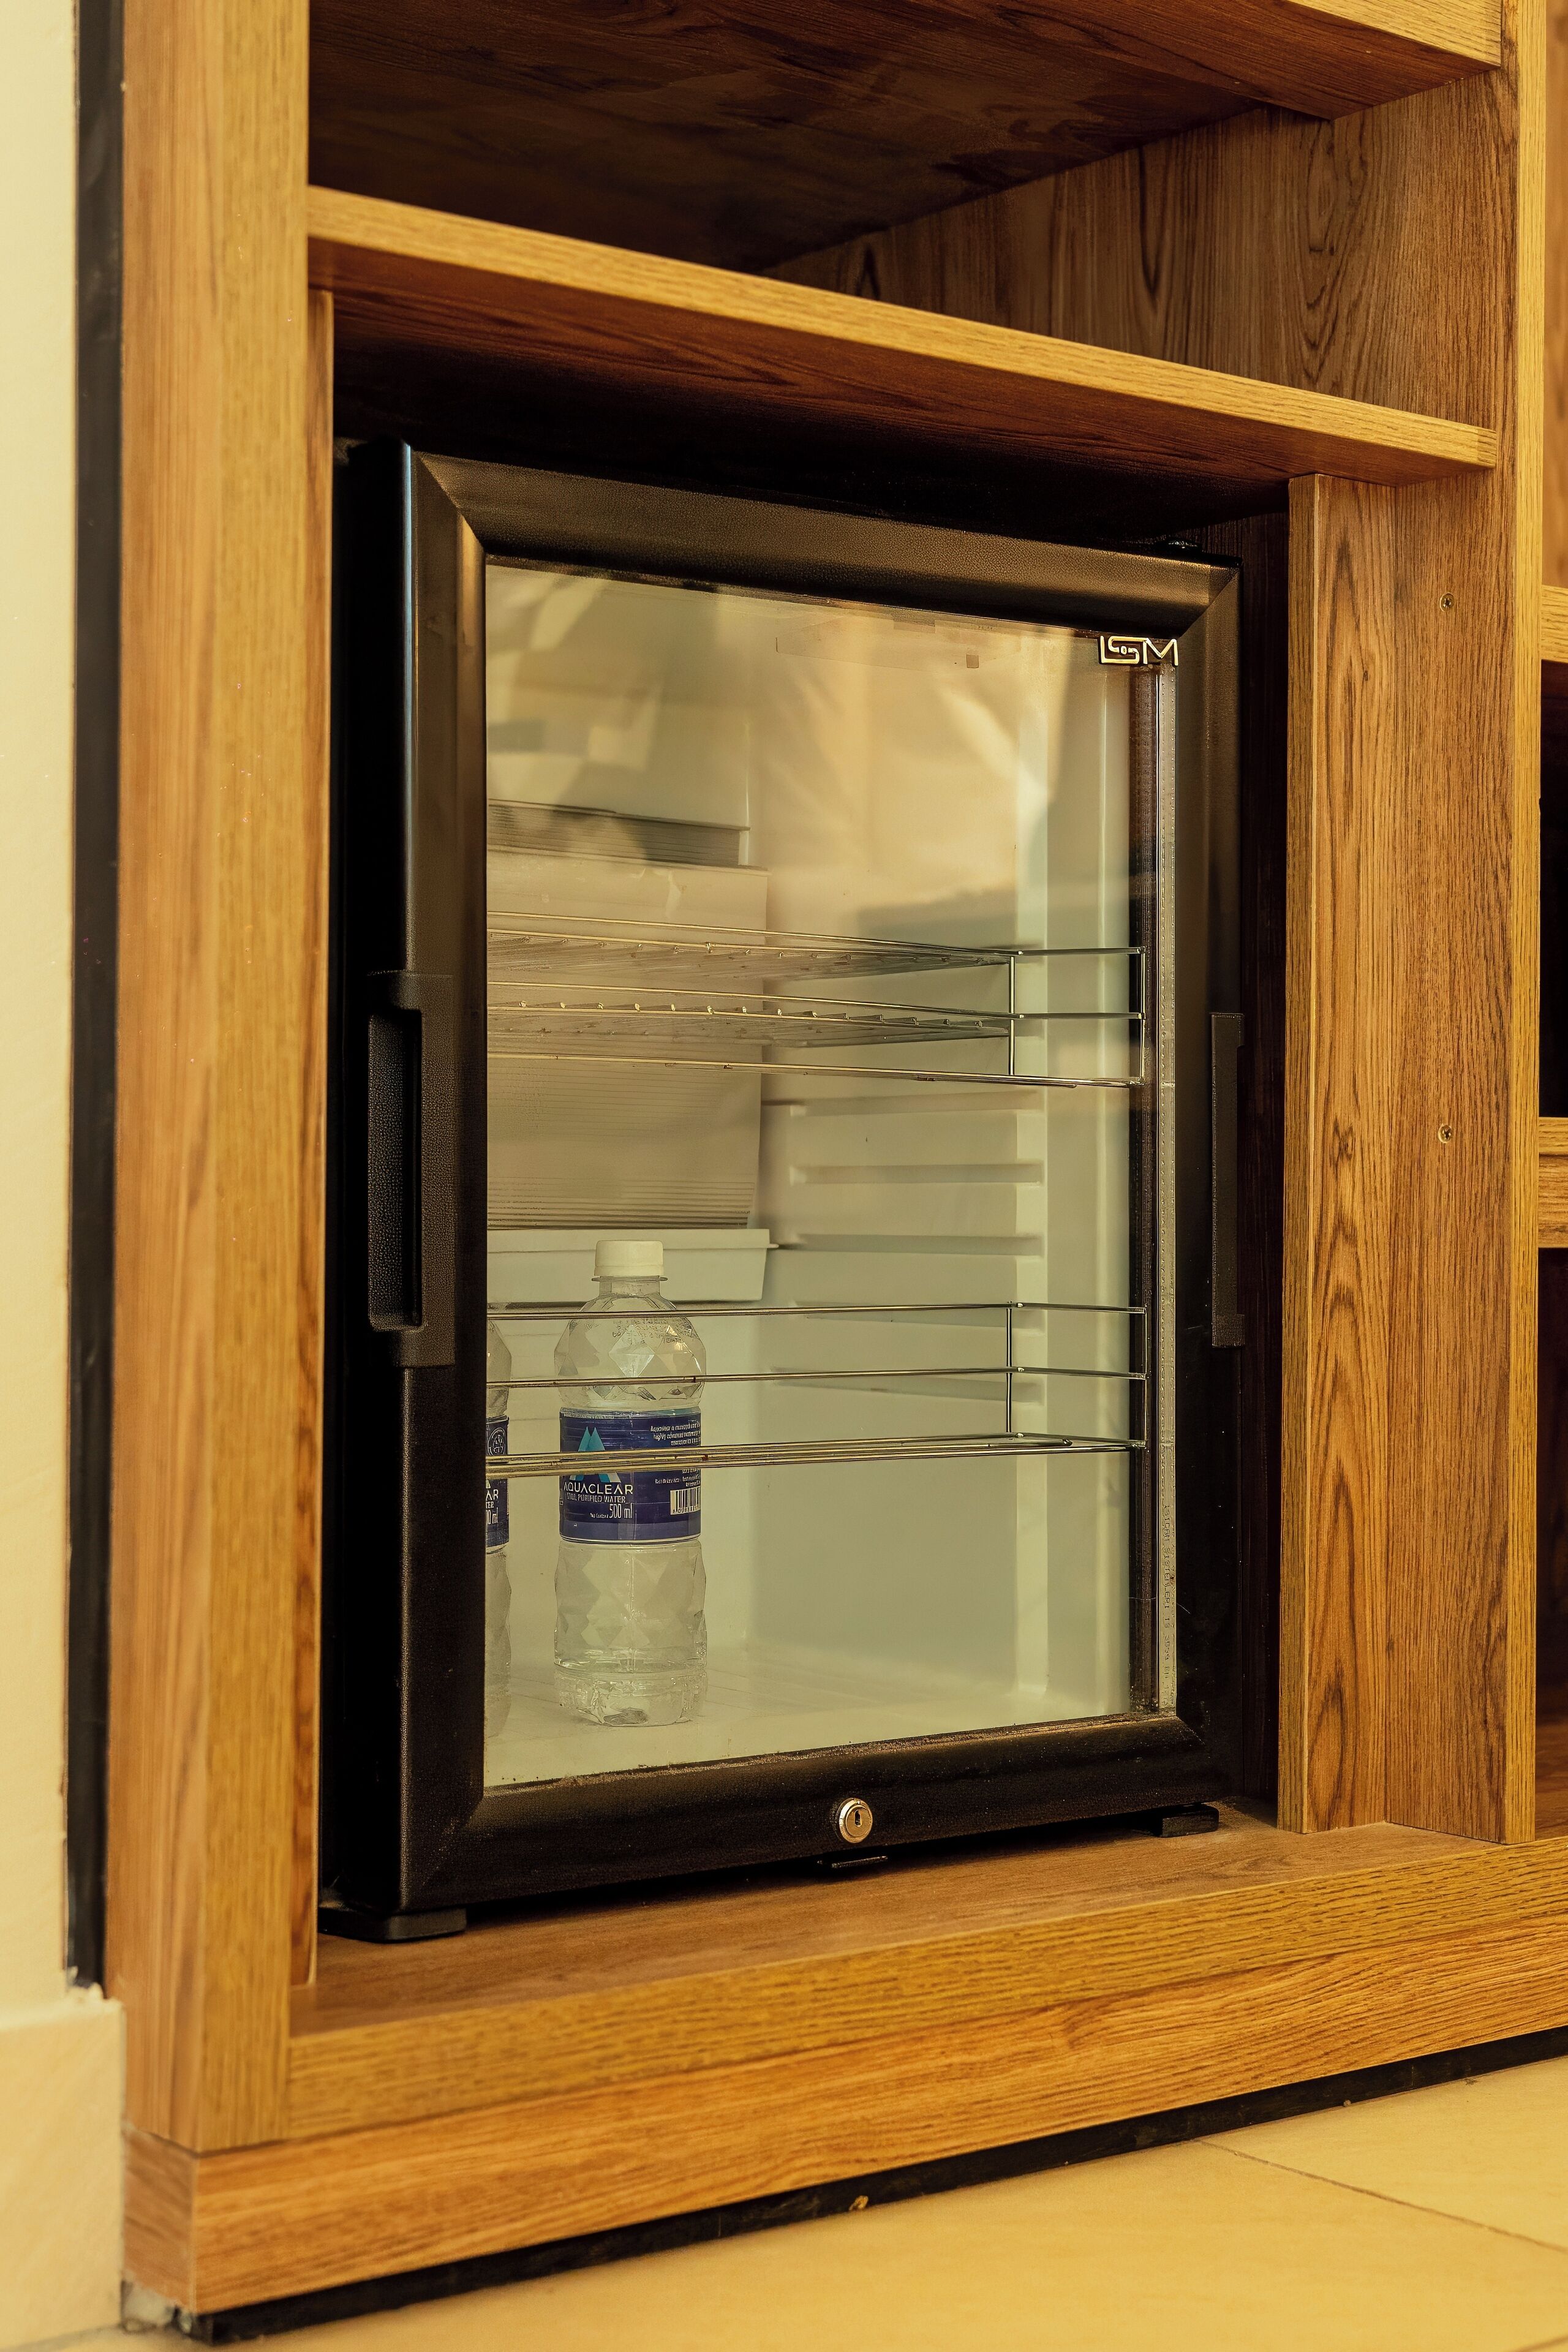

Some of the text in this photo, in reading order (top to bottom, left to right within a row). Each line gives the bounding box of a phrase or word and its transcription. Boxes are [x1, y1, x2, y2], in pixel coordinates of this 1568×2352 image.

[564, 1482, 633, 1494] AQUACLEAR
[609, 1504, 622, 1518] 500
[624, 1502, 632, 1519] ml
